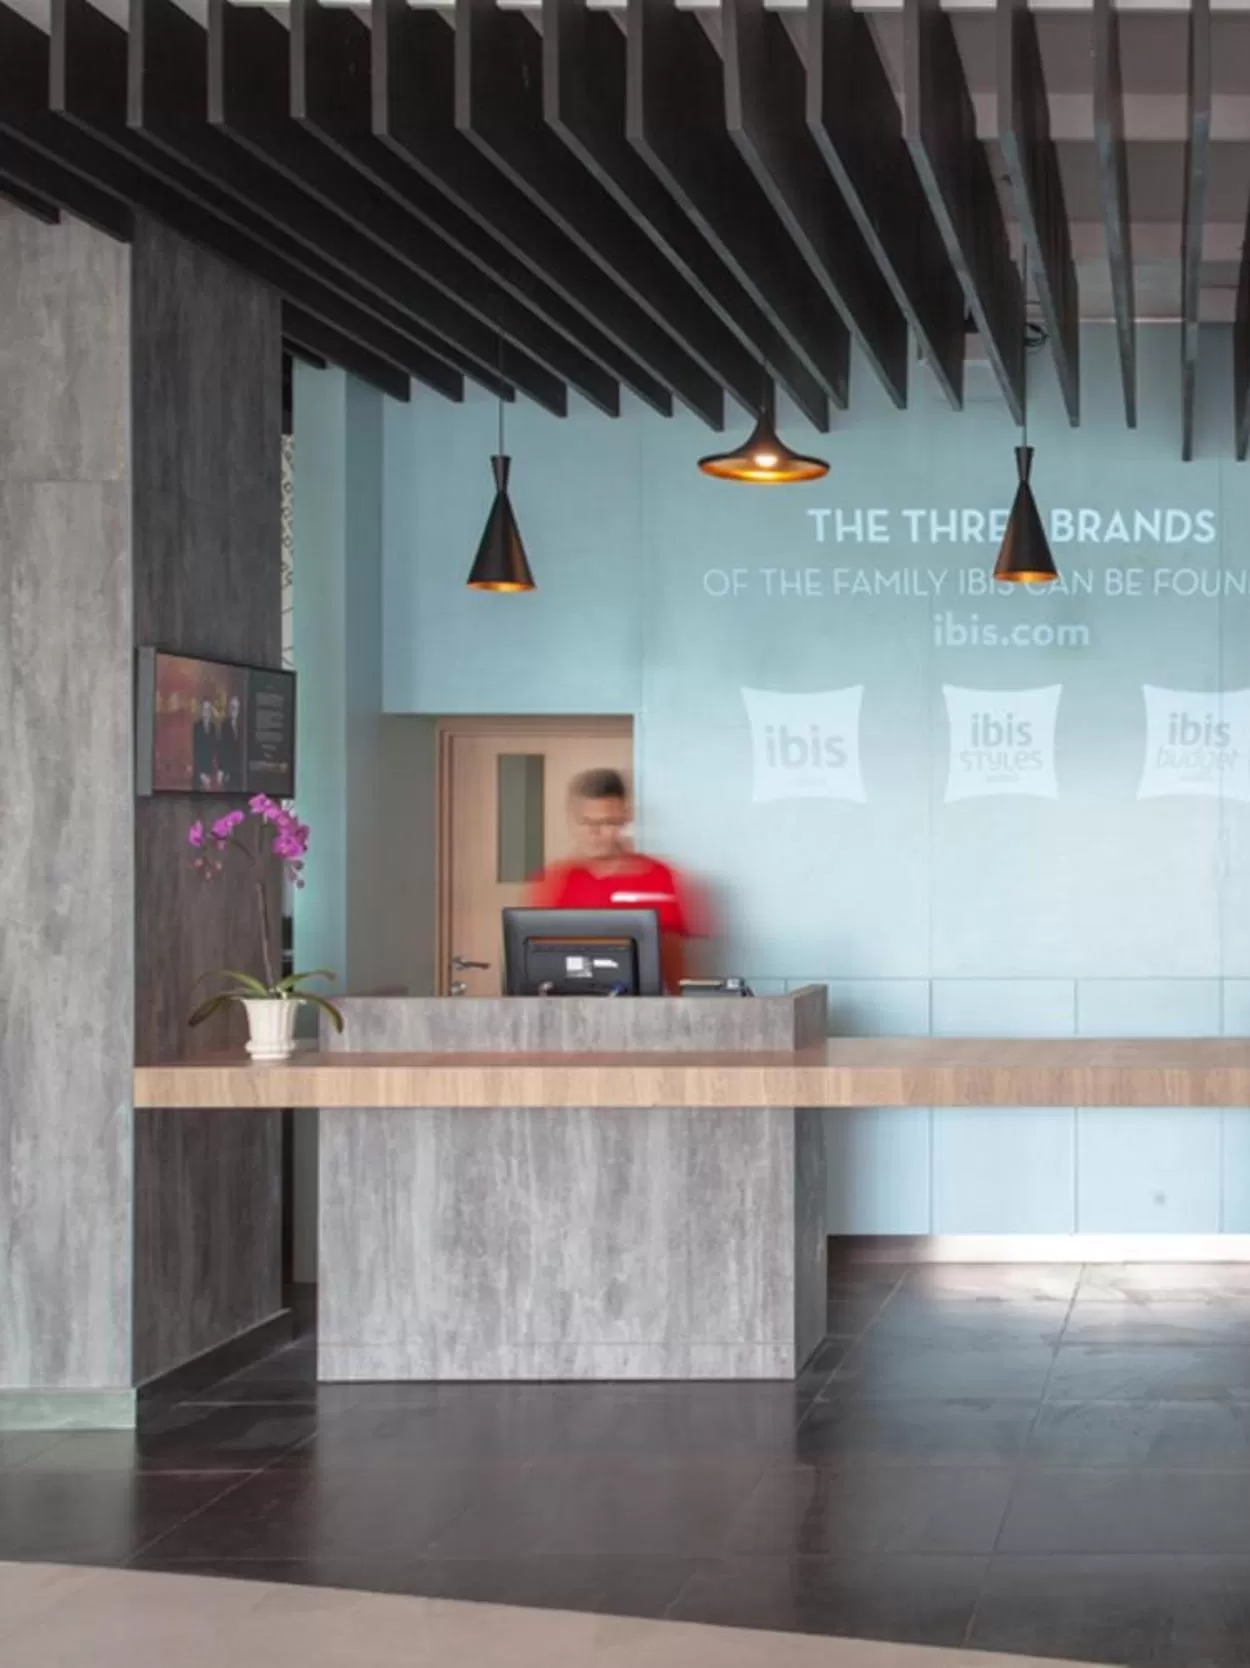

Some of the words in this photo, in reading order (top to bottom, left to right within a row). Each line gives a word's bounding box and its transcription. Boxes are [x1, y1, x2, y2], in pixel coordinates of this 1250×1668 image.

[807, 508, 890, 543] THE
[902, 508, 1016, 543] THRE
[1051, 508, 1217, 544] BRANDS
[703, 568, 749, 597] OF
[760, 568, 823, 597] THE
[833, 568, 948, 597] FAMILY
[1105, 567, 1144, 597] BE
[933, 611, 1091, 648] ibis.com
[764, 723, 848, 770] ibis
[971, 712, 1033, 748] ibis
[1168, 711, 1232, 747] ibis
